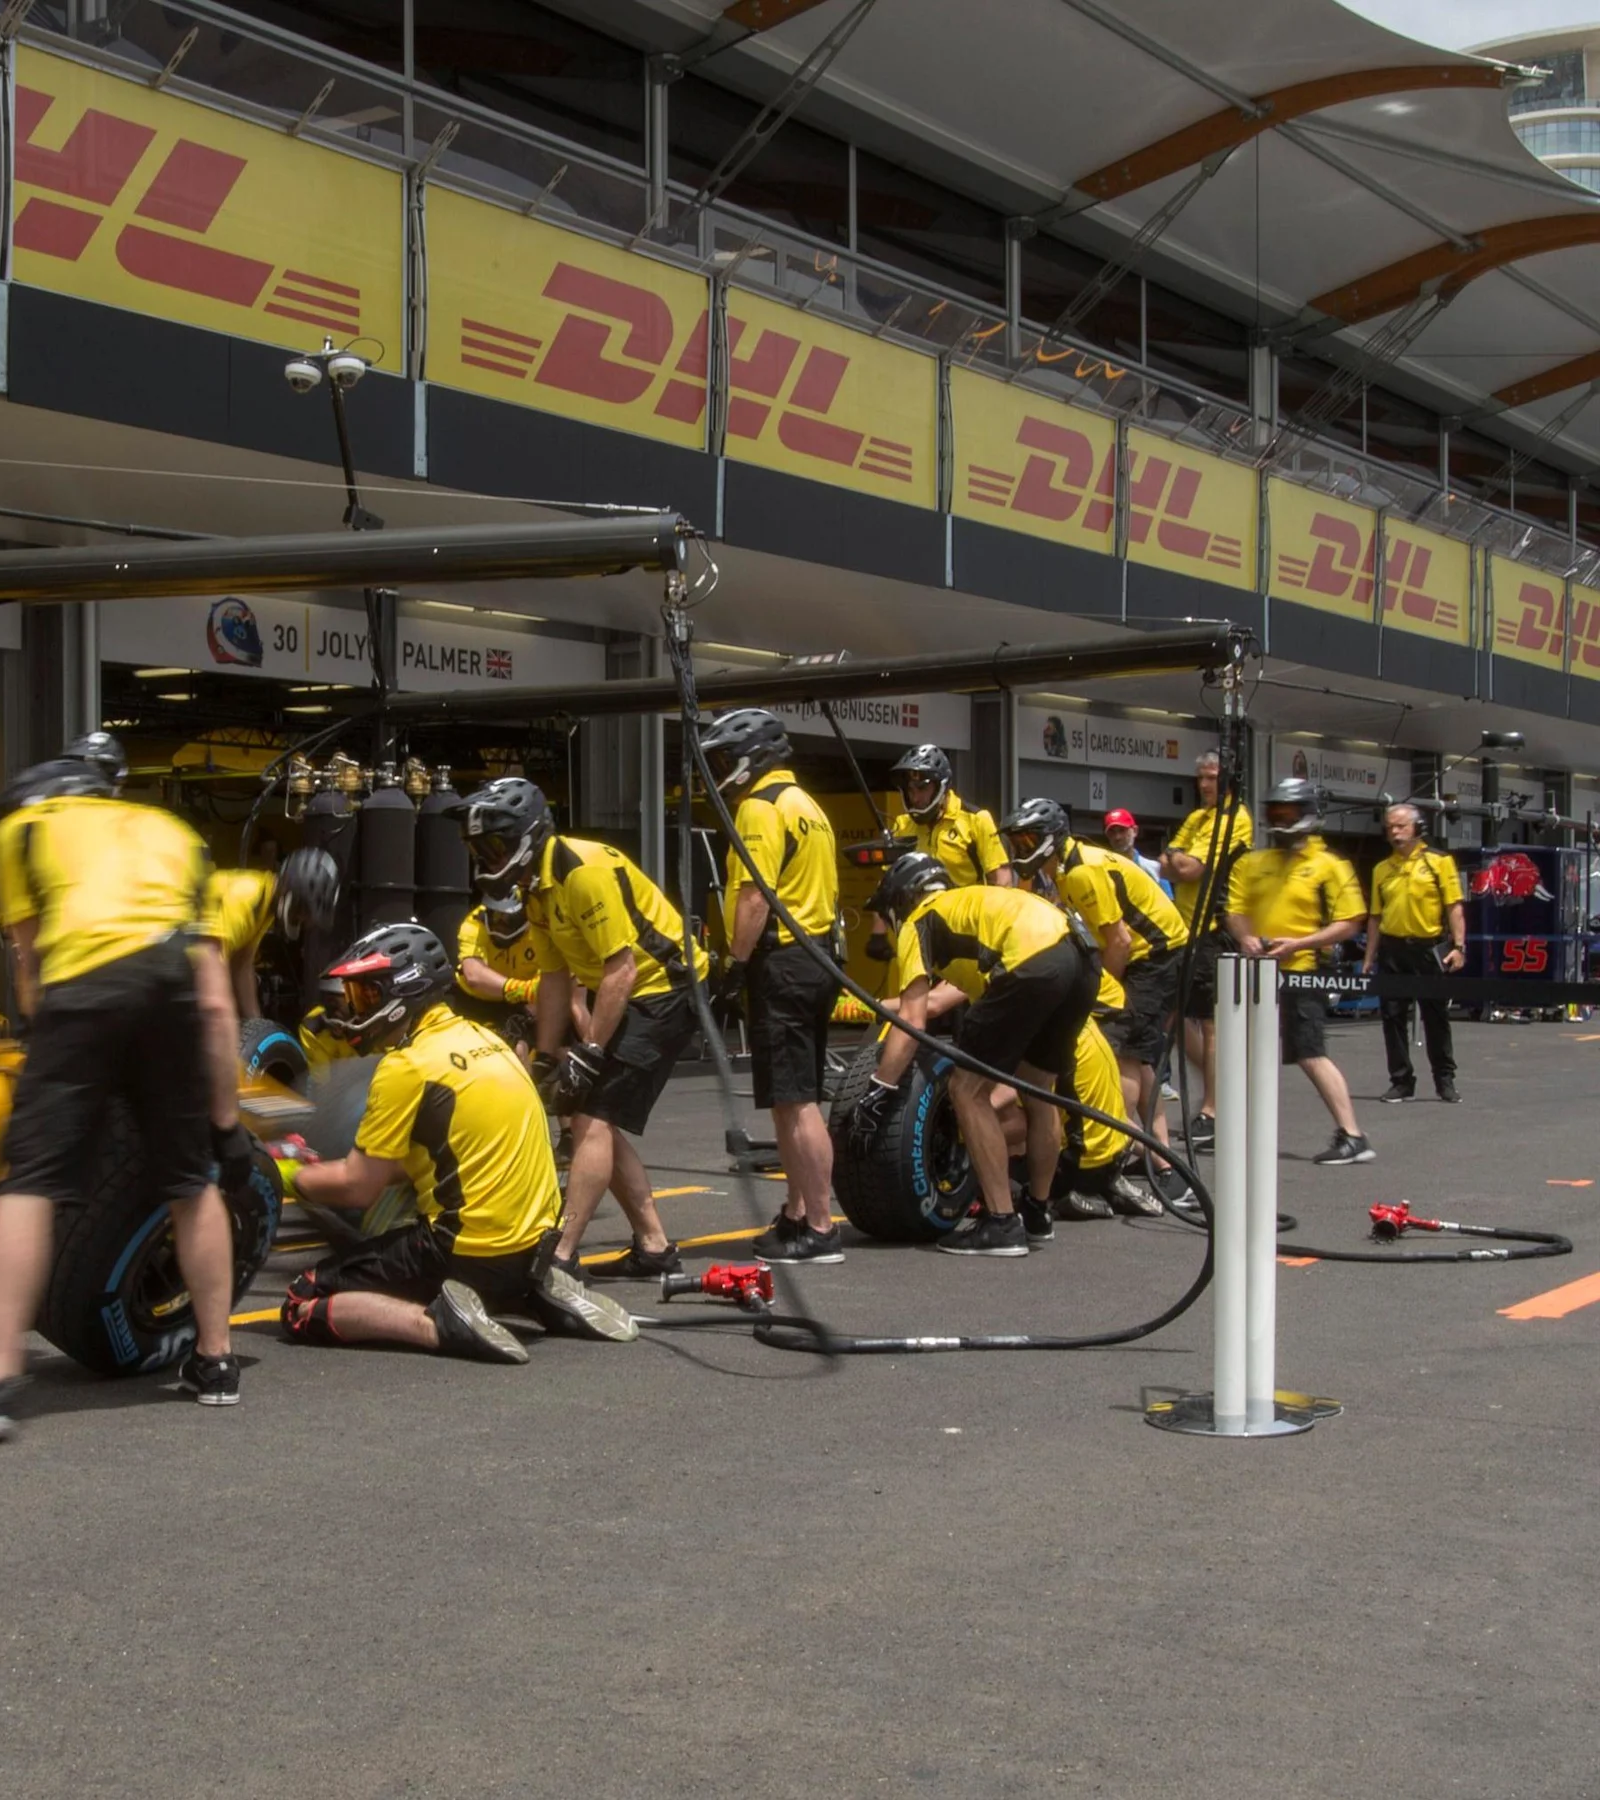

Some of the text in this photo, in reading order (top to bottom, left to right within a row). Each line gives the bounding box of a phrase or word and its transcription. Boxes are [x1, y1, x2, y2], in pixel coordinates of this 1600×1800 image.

[534, 262, 865, 467] DHL
[1011, 416, 1213, 561] DHL
[1306, 512, 1439, 623] DHL
[273, 624, 482, 676] 30 JOLY PALMER
[1072, 731, 1165, 759] 55 CARLOS SAINZ Jr
[1092, 782, 1104, 799] 26
[1501, 938, 1548, 972] 55
[1288, 975, 1371, 991] RENAULT
